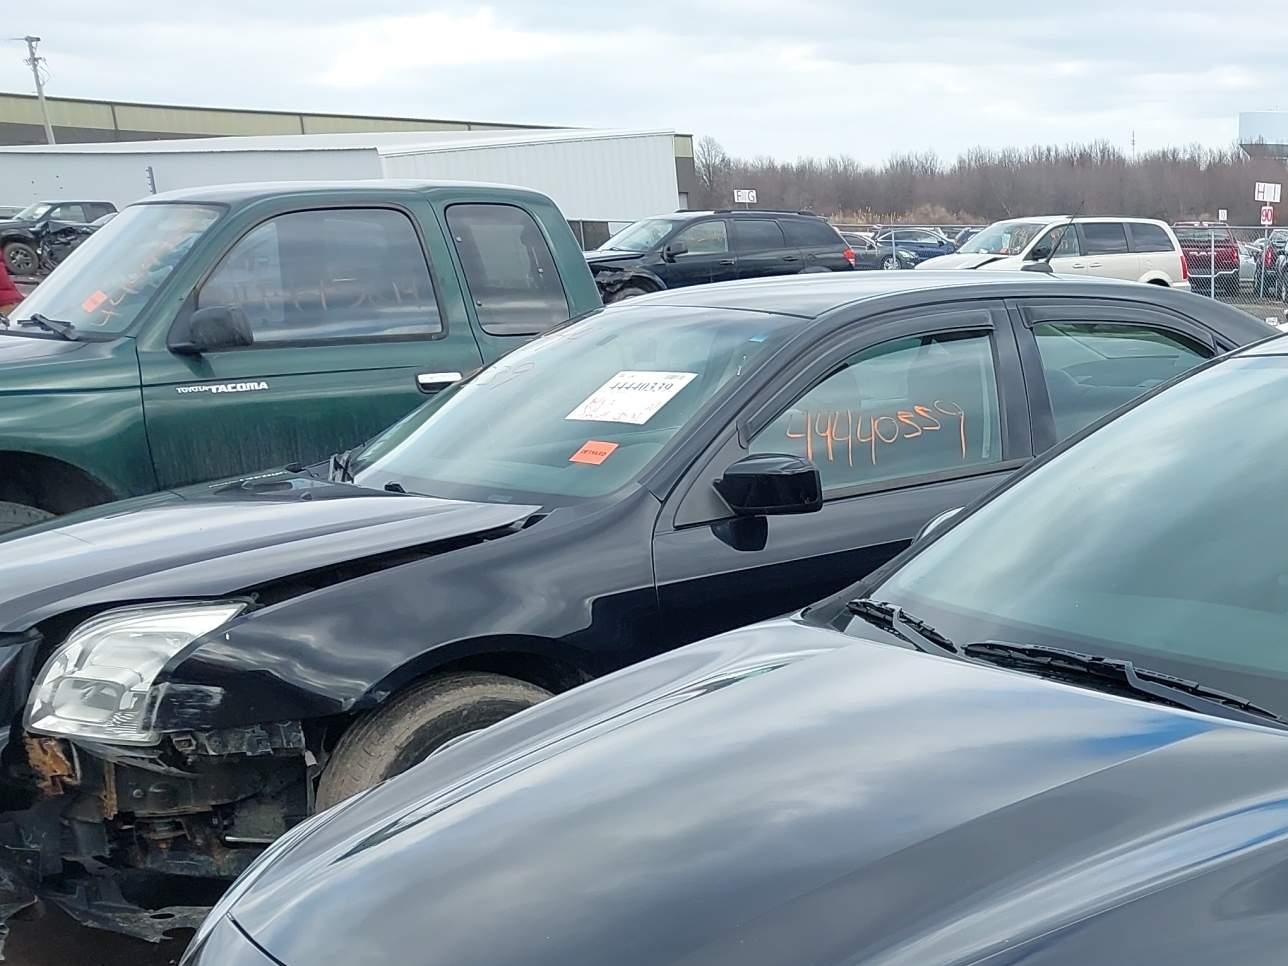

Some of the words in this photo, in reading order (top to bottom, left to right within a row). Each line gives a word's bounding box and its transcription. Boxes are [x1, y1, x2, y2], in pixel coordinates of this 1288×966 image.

[736, 190, 742, 201] F
[748, 190, 755, 202] G
[1256, 183, 1265, 200] H
[1262, 208, 1274, 222] 90
[209, 381, 269, 394] TACOMA
